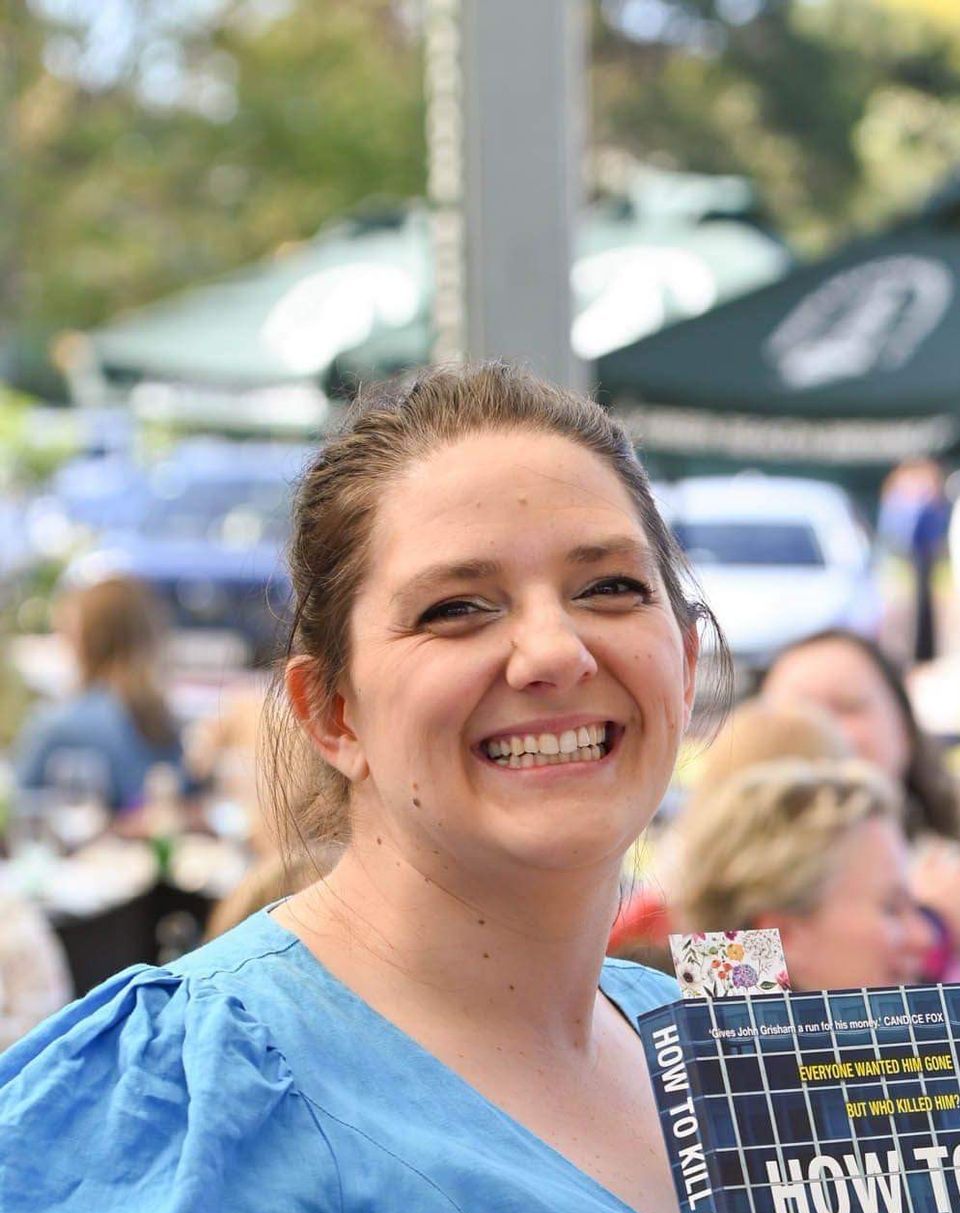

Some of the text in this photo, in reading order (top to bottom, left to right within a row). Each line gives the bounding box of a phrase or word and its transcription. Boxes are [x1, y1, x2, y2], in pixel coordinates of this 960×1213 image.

[737, 1027, 758, 1037] John
[760, 1025, 796, 1036] Grisham
[798, 1025, 804, 1033] a
[805, 1023, 820, 1032] run
[821, 1021, 833, 1032] for
[835, 1020, 848, 1030] his
[884, 1014, 924, 1026] CANDICE
[926, 1012, 945, 1024] FOX
[652, 1024, 690, 1093] HOW
[800, 1055, 953, 1081] EVERYONE WANTED HIM GONE
[669, 1096, 699, 1139] TO
[846, 1094, 960, 1118] BUT WHO KILLED HIM?
[678, 1143, 713, 1211] KILL
